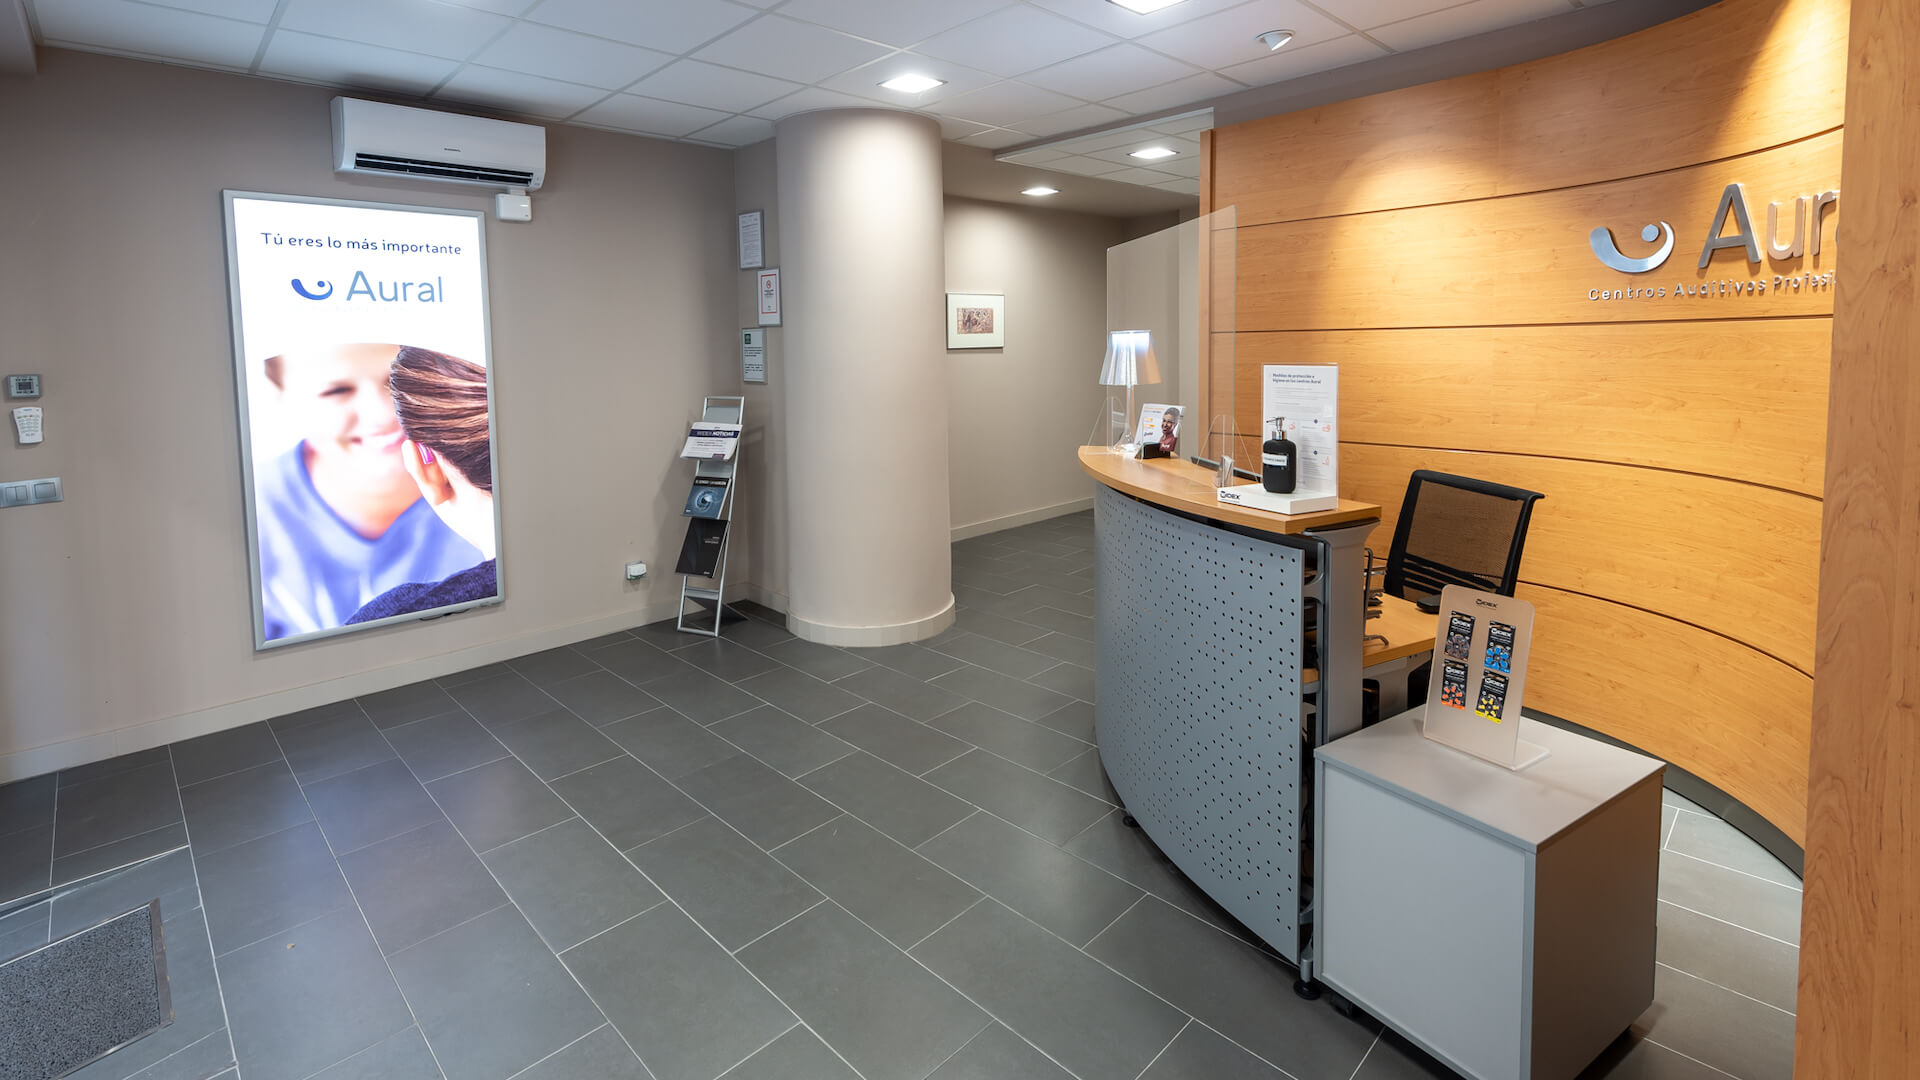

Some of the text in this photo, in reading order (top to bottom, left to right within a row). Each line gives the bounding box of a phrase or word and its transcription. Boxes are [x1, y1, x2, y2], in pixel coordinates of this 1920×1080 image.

[1698, 183, 1841, 269] Aur
[260, 232, 461, 255] Tú eres lo más importante
[346, 270, 443, 303] Aural
[1588, 270, 1837, 301] Centros Auditivos Profesi
